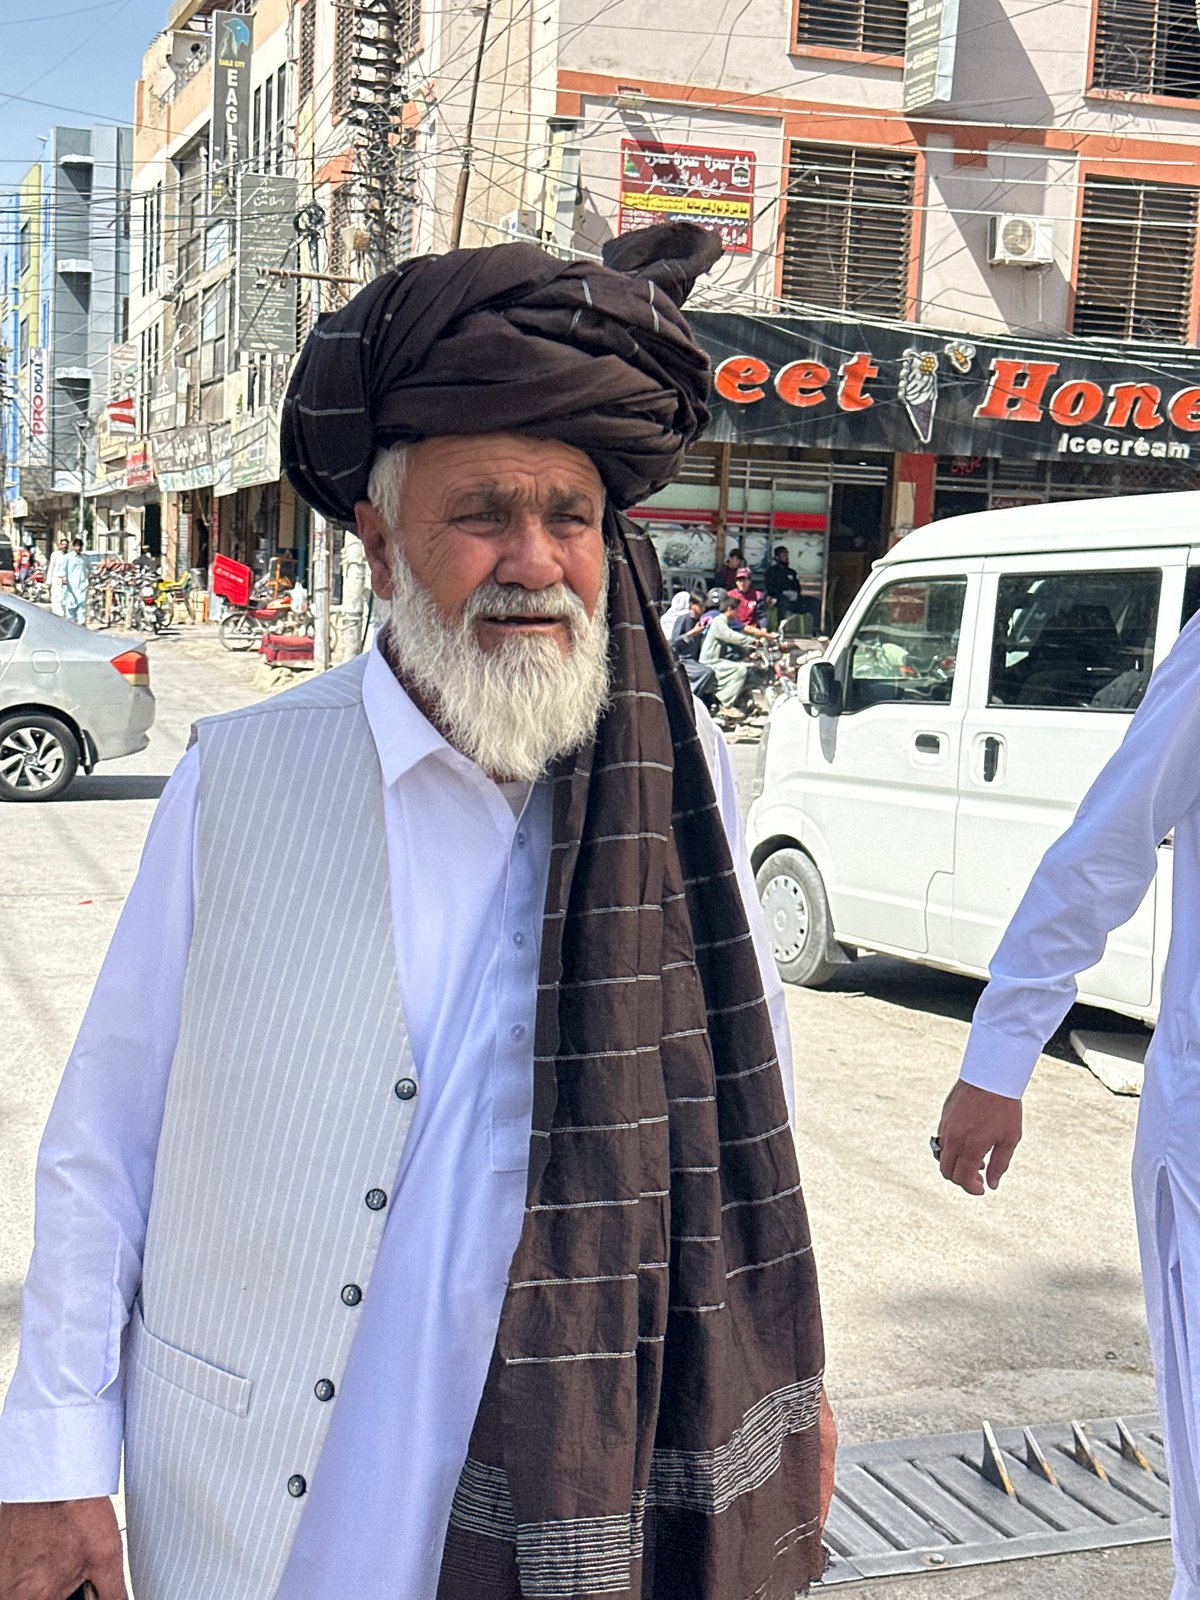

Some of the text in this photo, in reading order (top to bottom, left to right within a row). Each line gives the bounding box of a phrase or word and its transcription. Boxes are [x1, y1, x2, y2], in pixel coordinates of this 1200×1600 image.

[713, 352, 1200, 432] eet Hone
[1057, 433, 1191, 459] Icecream
